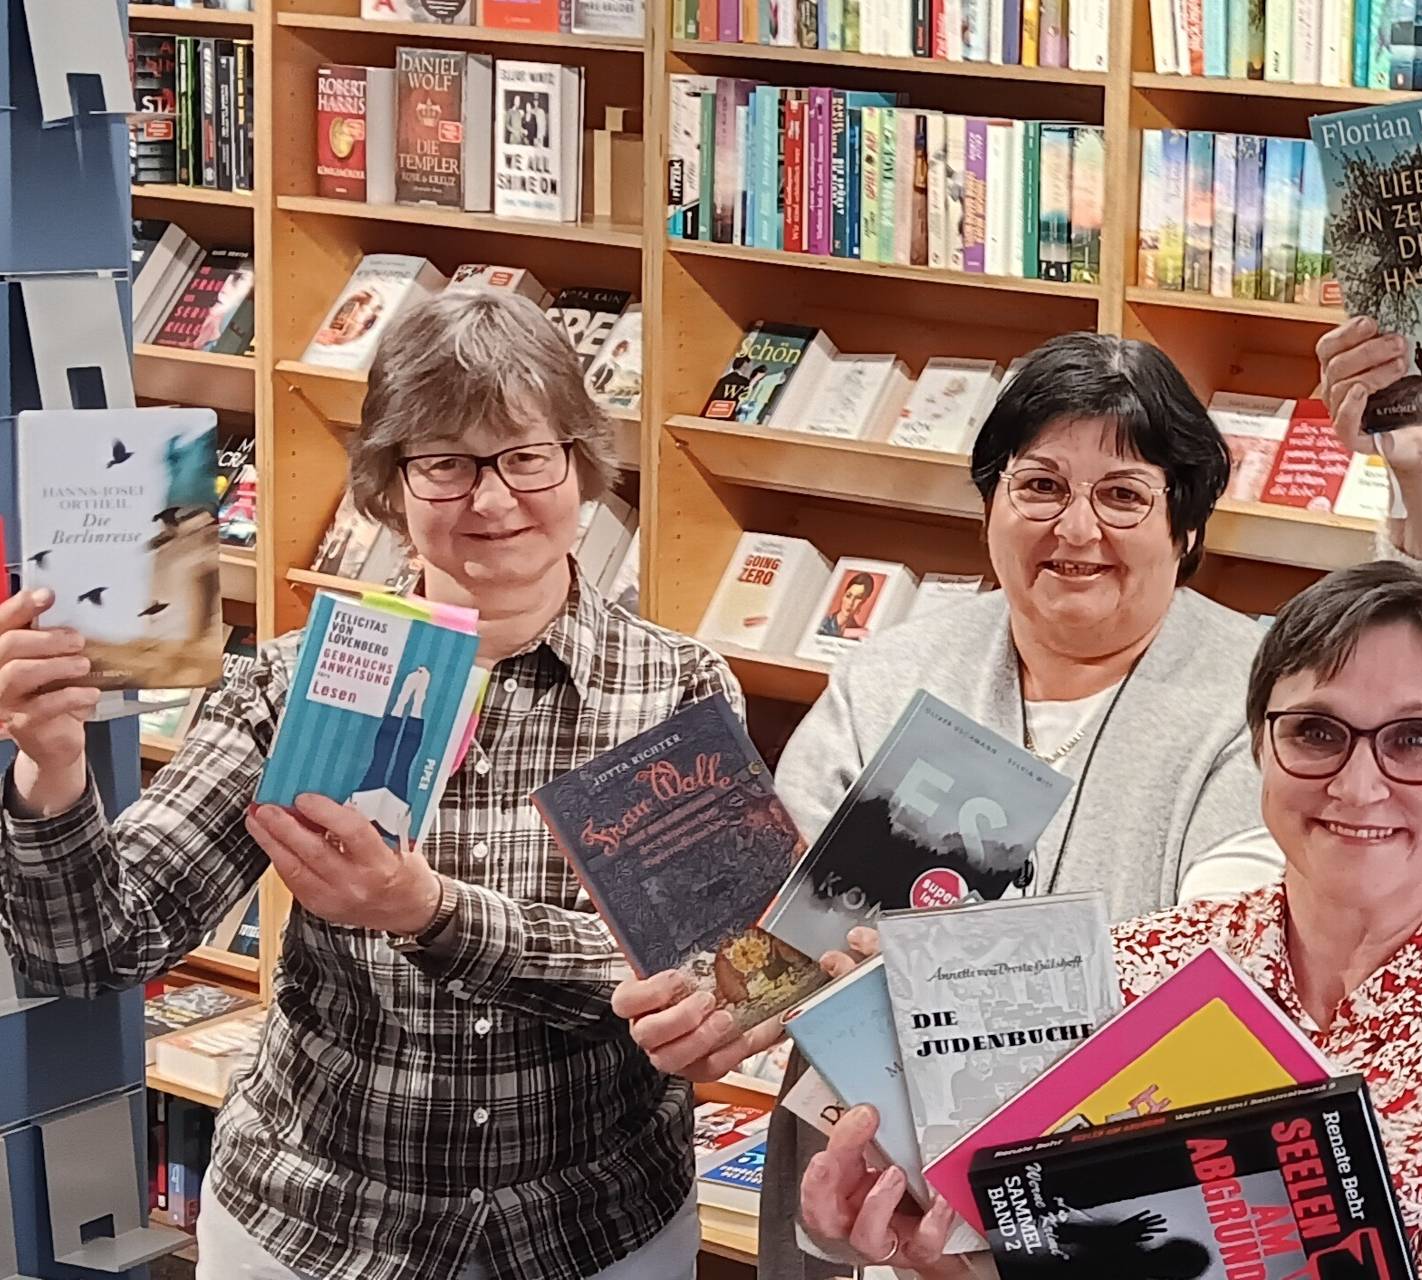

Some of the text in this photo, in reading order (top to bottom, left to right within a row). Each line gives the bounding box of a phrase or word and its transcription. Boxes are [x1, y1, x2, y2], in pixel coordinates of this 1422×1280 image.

[401, 53, 459, 76] DANIEL
[317, 77, 367, 97] ROBERT
[408, 72, 452, 92] WOLF
[317, 94, 366, 114] HARRIS
[1321, 116, 1412, 149] Florian
[416, 138, 440, 156] DIE
[399, 153, 460, 174] TEMPLER
[504, 153, 552, 174] WE ALL
[497, 173, 558, 195] SHINE ON
[1357, 208, 1384, 233] IN
[735, 333, 801, 365] Schön
[82, 513, 111, 528] Die
[51, 530, 143, 545] Berlinreise
[744, 554, 782, 570] GOING
[737, 567, 775, 586] ZERO
[332, 622, 354, 636] VON
[334, 611, 389, 634] FELICITAS
[327, 632, 390, 657] LOVENBERG
[319, 660, 391, 687] ANWEISUNG
[322, 648, 394, 674] GEBRAUCHS
[312, 681, 358, 704] Lesen
[591, 733, 683, 787] JUTTA RICHTER
[418, 758, 437, 791] PIPER
[894, 757, 1008, 868] ES
[581, 802, 651, 856] Frau
[911, 1010, 959, 1030] DIE
[915, 1022, 1096, 1058] JUDENBUCHE
[1322, 1110, 1365, 1221] Renate Behr
[1270, 1117, 1342, 1240] SEELEN
[987, 1186, 1022, 1252] BAND 2
[1004, 1174, 1043, 1255] SAMMEL
[1185, 1138, 1268, 1280] ABGRUND
[1250, 1204, 1302, 1257] AM
